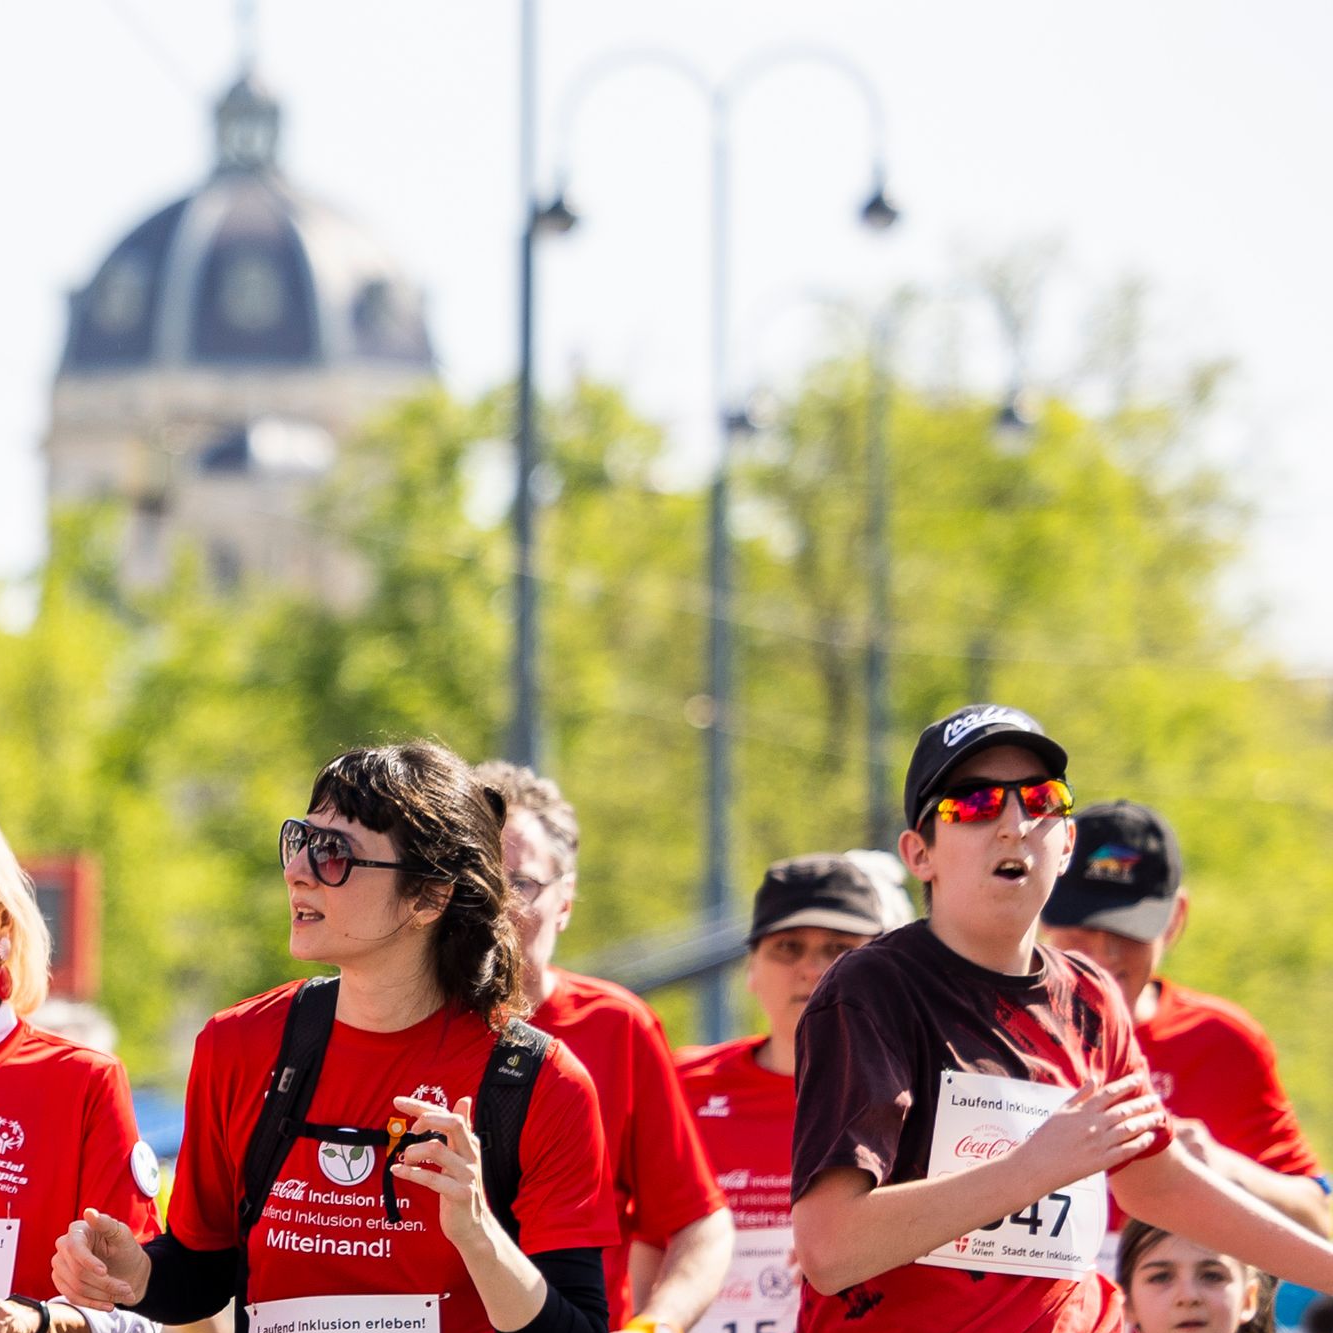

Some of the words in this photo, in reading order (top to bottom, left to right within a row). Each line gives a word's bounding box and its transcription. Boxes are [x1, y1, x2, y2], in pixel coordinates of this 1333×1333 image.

[498, 1066, 524, 1079] deuter
[951, 1095, 1002, 1110] Laufend
[1005, 1101, 1050, 1117] Inklusion
[309, 1190, 375, 1207] Inclusion
[262, 1205, 291, 1222] ufend
[295, 1210, 361, 1228] Inklusion
[980, 1193, 1071, 1237] 47
[267, 1228, 391, 1258] Miteinand!
[971, 1248, 994, 1257] Wien
[972, 1238, 995, 1248] Stadt
[1001, 1245, 1026, 1257] Stadt
[1029, 1248, 1044, 1258] der
[298, 1318, 360, 1331] Inklusion
[366, 1318, 425, 1329] erleben!
